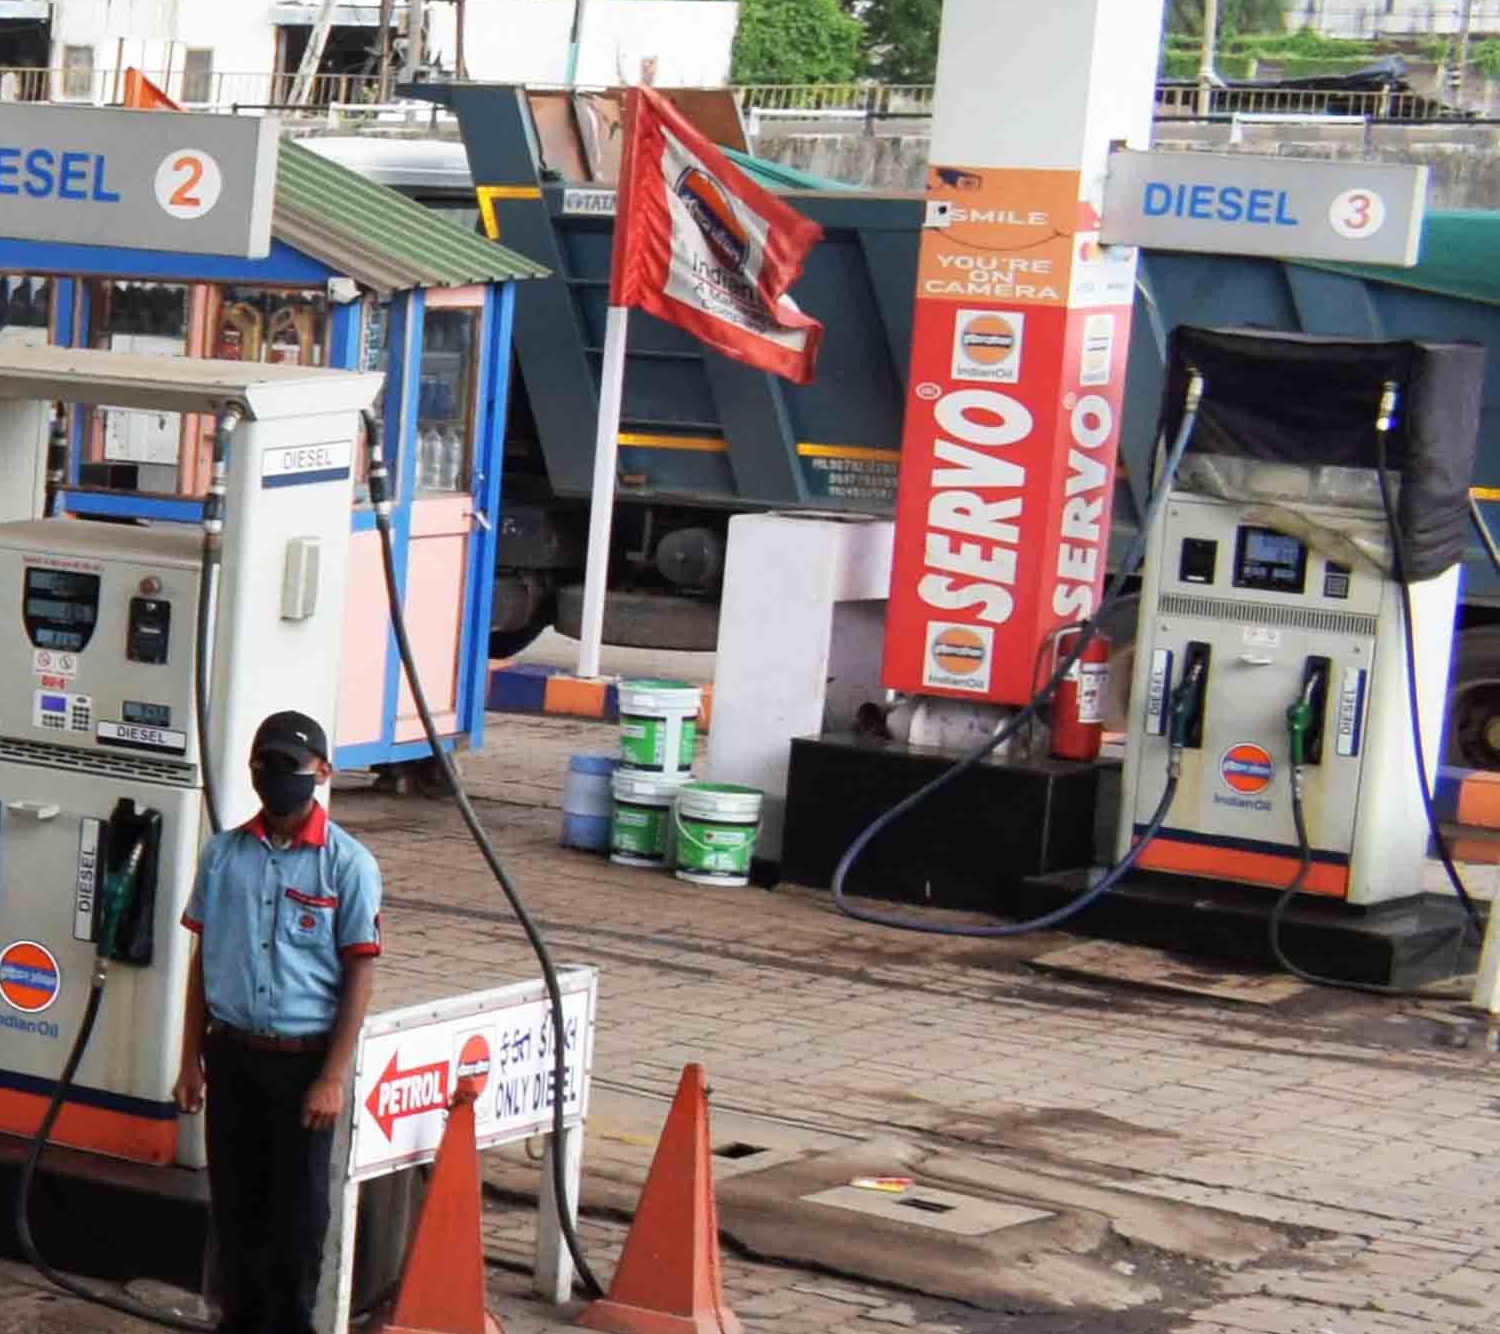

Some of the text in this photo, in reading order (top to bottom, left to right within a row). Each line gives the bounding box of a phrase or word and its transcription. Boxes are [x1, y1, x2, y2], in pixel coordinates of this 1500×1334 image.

[167, 156, 204, 208] 2
[953, 208, 1049, 225] SMILE
[1142, 181, 1372, 229] DIESEL 3
[937, 255, 1052, 274] YOU'RE
[969, 270, 1014, 283] ON
[925, 280, 1061, 299] CAMERA
[283, 448, 333, 471] DIESEL
[917, 389, 1034, 625] SERVO
[1051, 393, 1113, 622] SERVO
[116, 725, 165, 744] DIESEL
[79, 850, 96, 913] DIESEL
[378, 1070, 444, 1118] PETROL
[495, 1079, 529, 1120] ONLY
